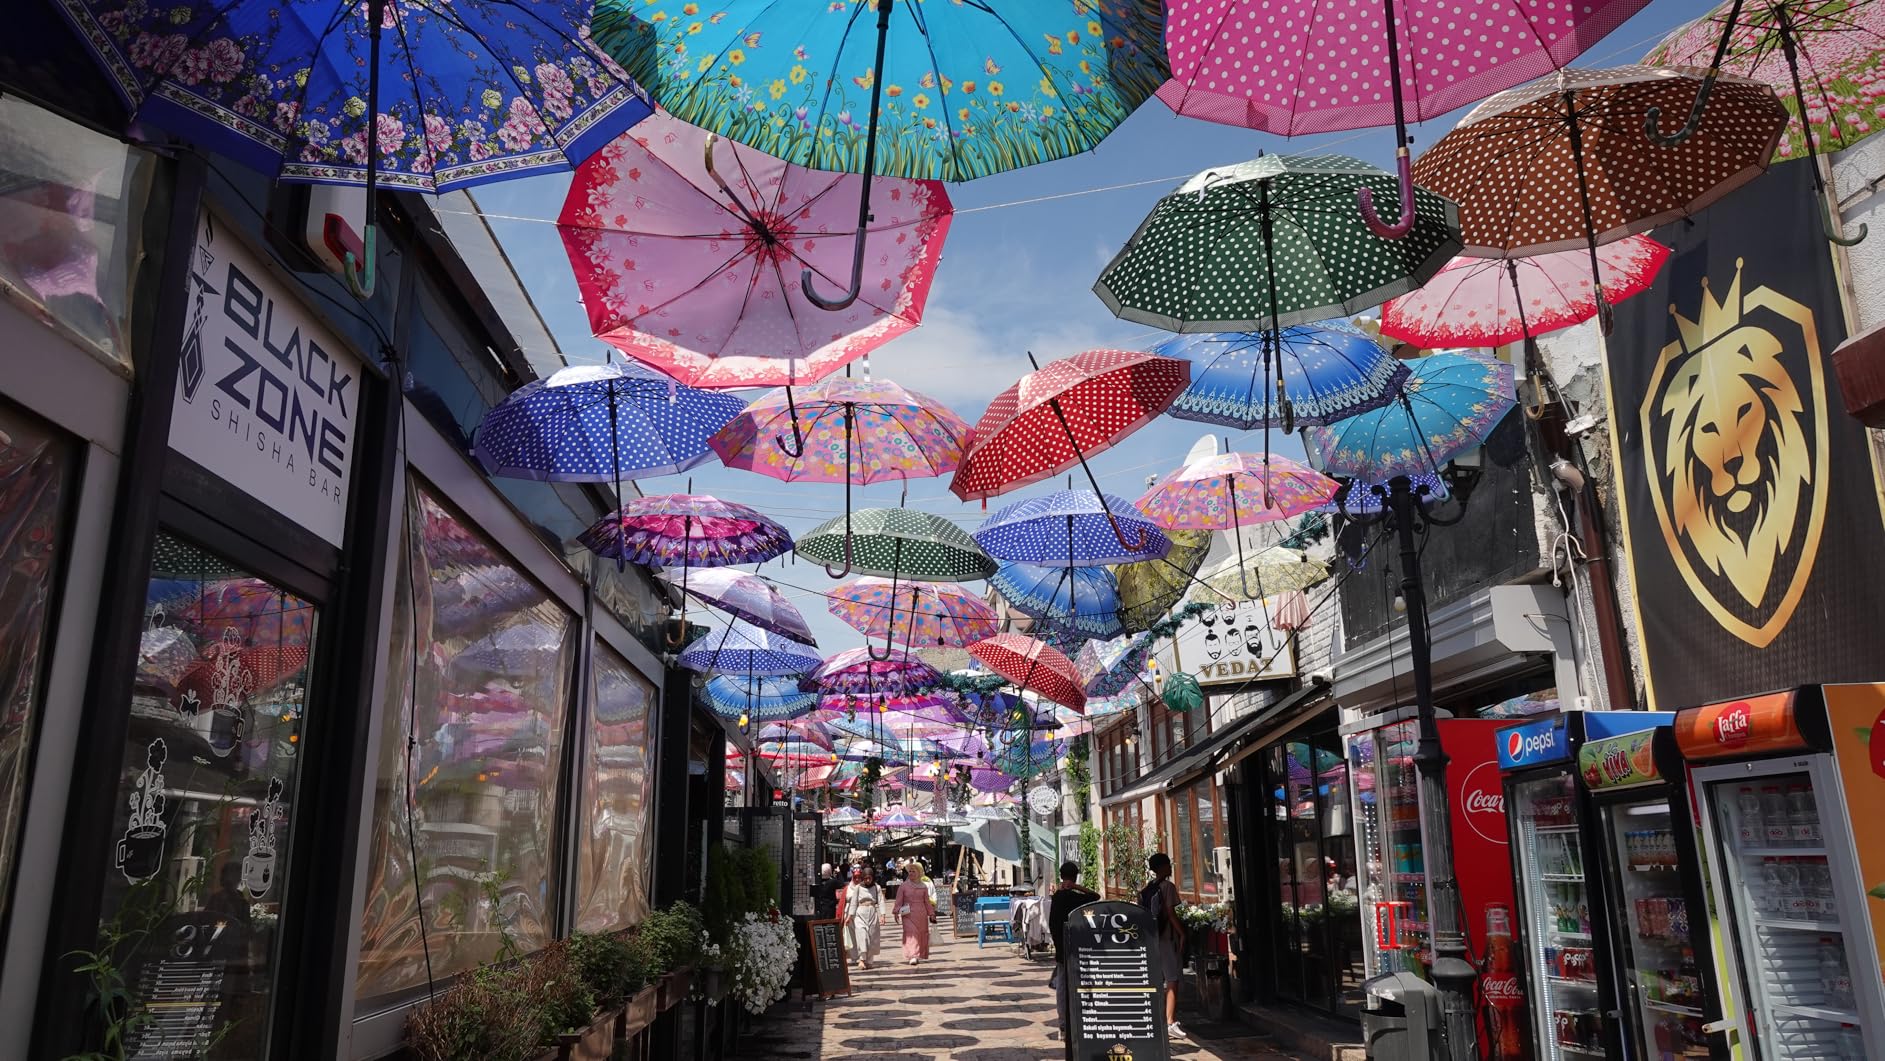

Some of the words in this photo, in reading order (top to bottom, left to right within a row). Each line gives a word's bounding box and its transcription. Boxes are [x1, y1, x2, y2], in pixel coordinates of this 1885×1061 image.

[223, 261, 352, 420] BLACK
[213, 335, 347, 479] ZONE
[210, 399, 295, 473] SHISHA
[308, 468, 342, 505] BAR
[1199, 656, 1275, 679] VEDAT
[1525, 727, 1555, 757] pepsi
[1717, 709, 1748, 743] Jaffa
[1083, 913, 1130, 944] VS
